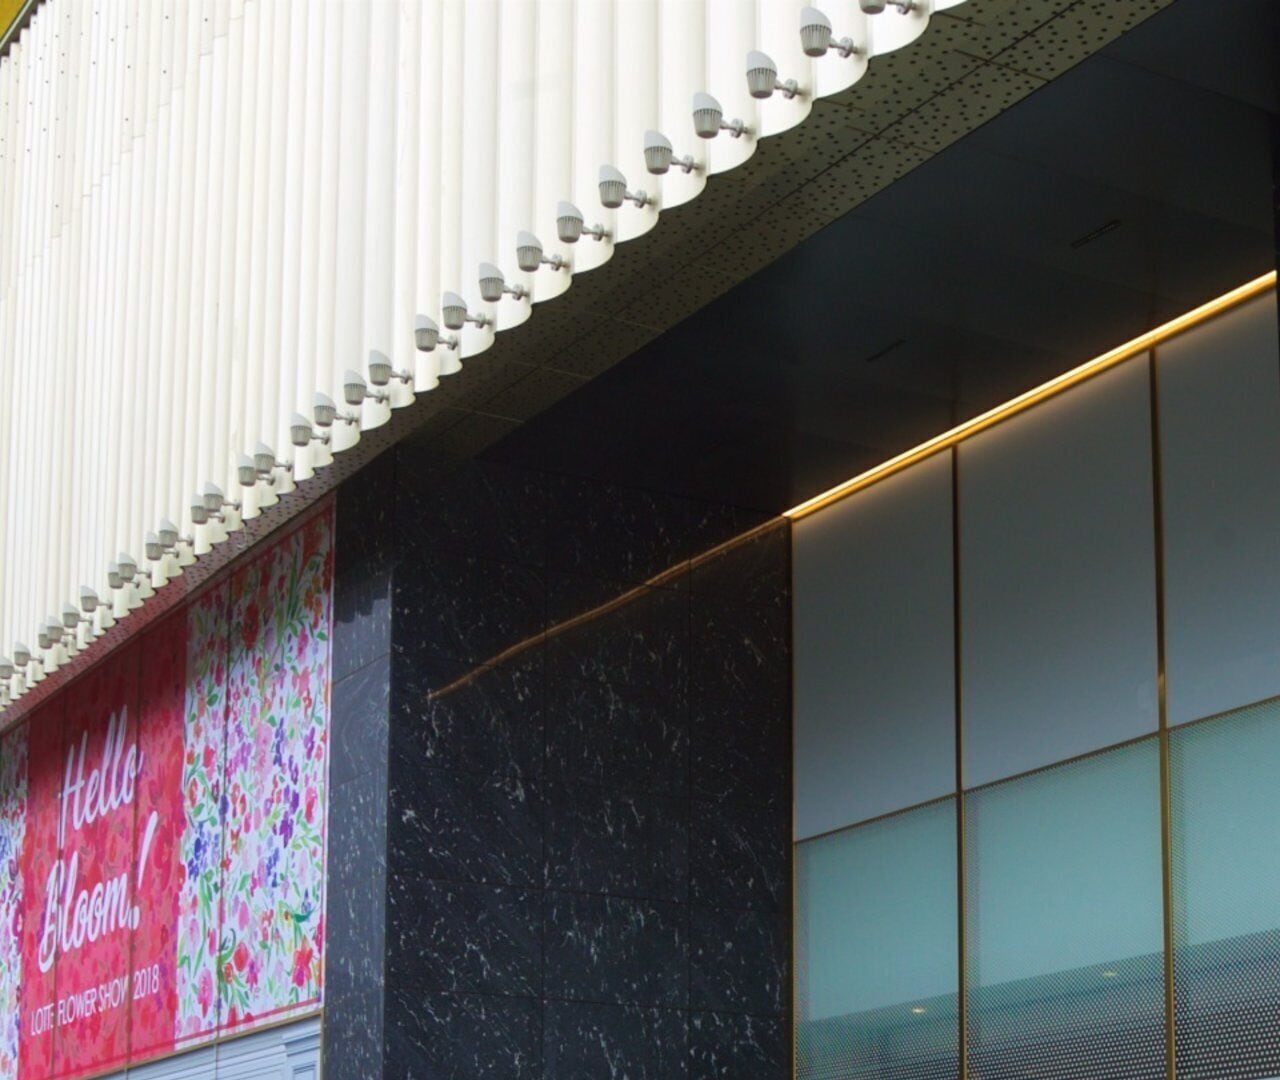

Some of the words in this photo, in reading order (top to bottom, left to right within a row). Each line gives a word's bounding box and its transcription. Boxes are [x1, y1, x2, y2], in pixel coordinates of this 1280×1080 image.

[55, 704, 145, 846] Hello
[37, 811, 158, 974] Bloom!
[57, 986, 97, 1027] FLOWER
[133, 963, 160, 1000] 2018
